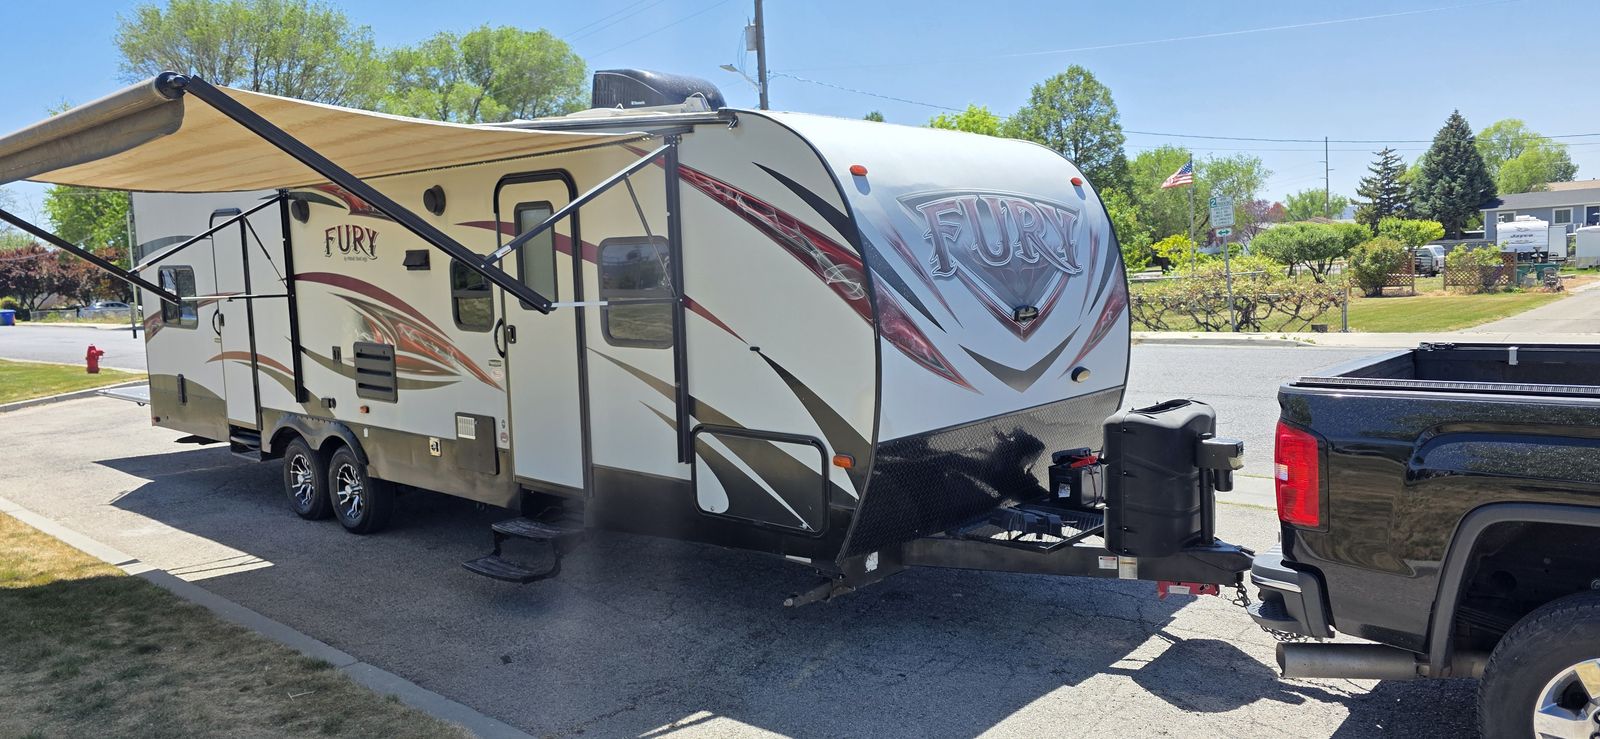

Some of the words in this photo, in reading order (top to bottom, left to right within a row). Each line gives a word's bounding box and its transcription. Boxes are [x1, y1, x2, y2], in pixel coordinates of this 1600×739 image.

[1210, 199, 1216, 207] 2
[324, 224, 379, 260] FURY
[916, 194, 1083, 277] FURY
